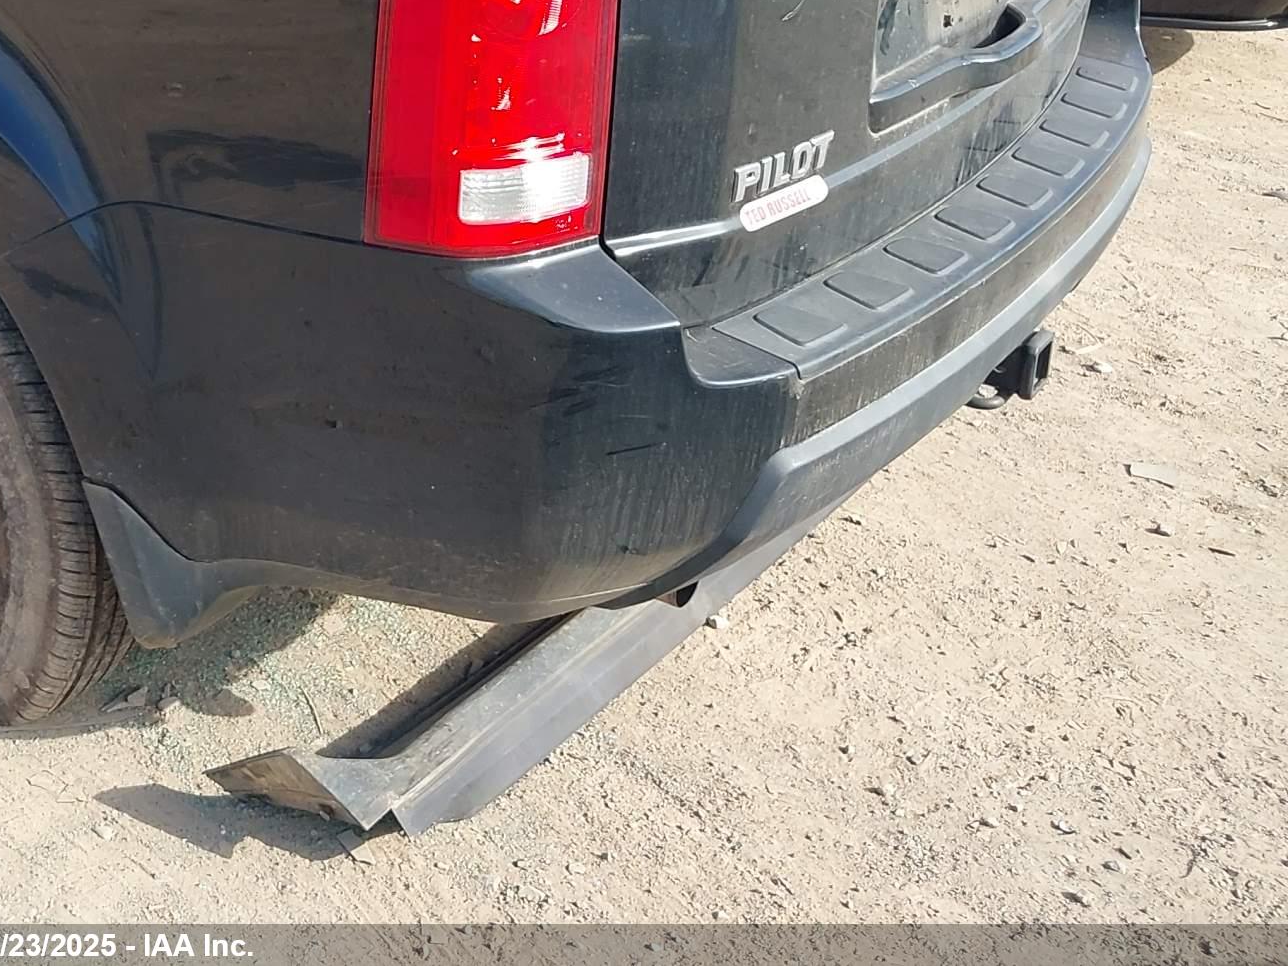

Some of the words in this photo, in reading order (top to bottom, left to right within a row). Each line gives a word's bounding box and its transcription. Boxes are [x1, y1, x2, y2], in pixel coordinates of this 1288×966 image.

[732, 129, 835, 203] PILOT
[744, 206, 767, 225] TED
[766, 188, 811, 218] RUSSELL
